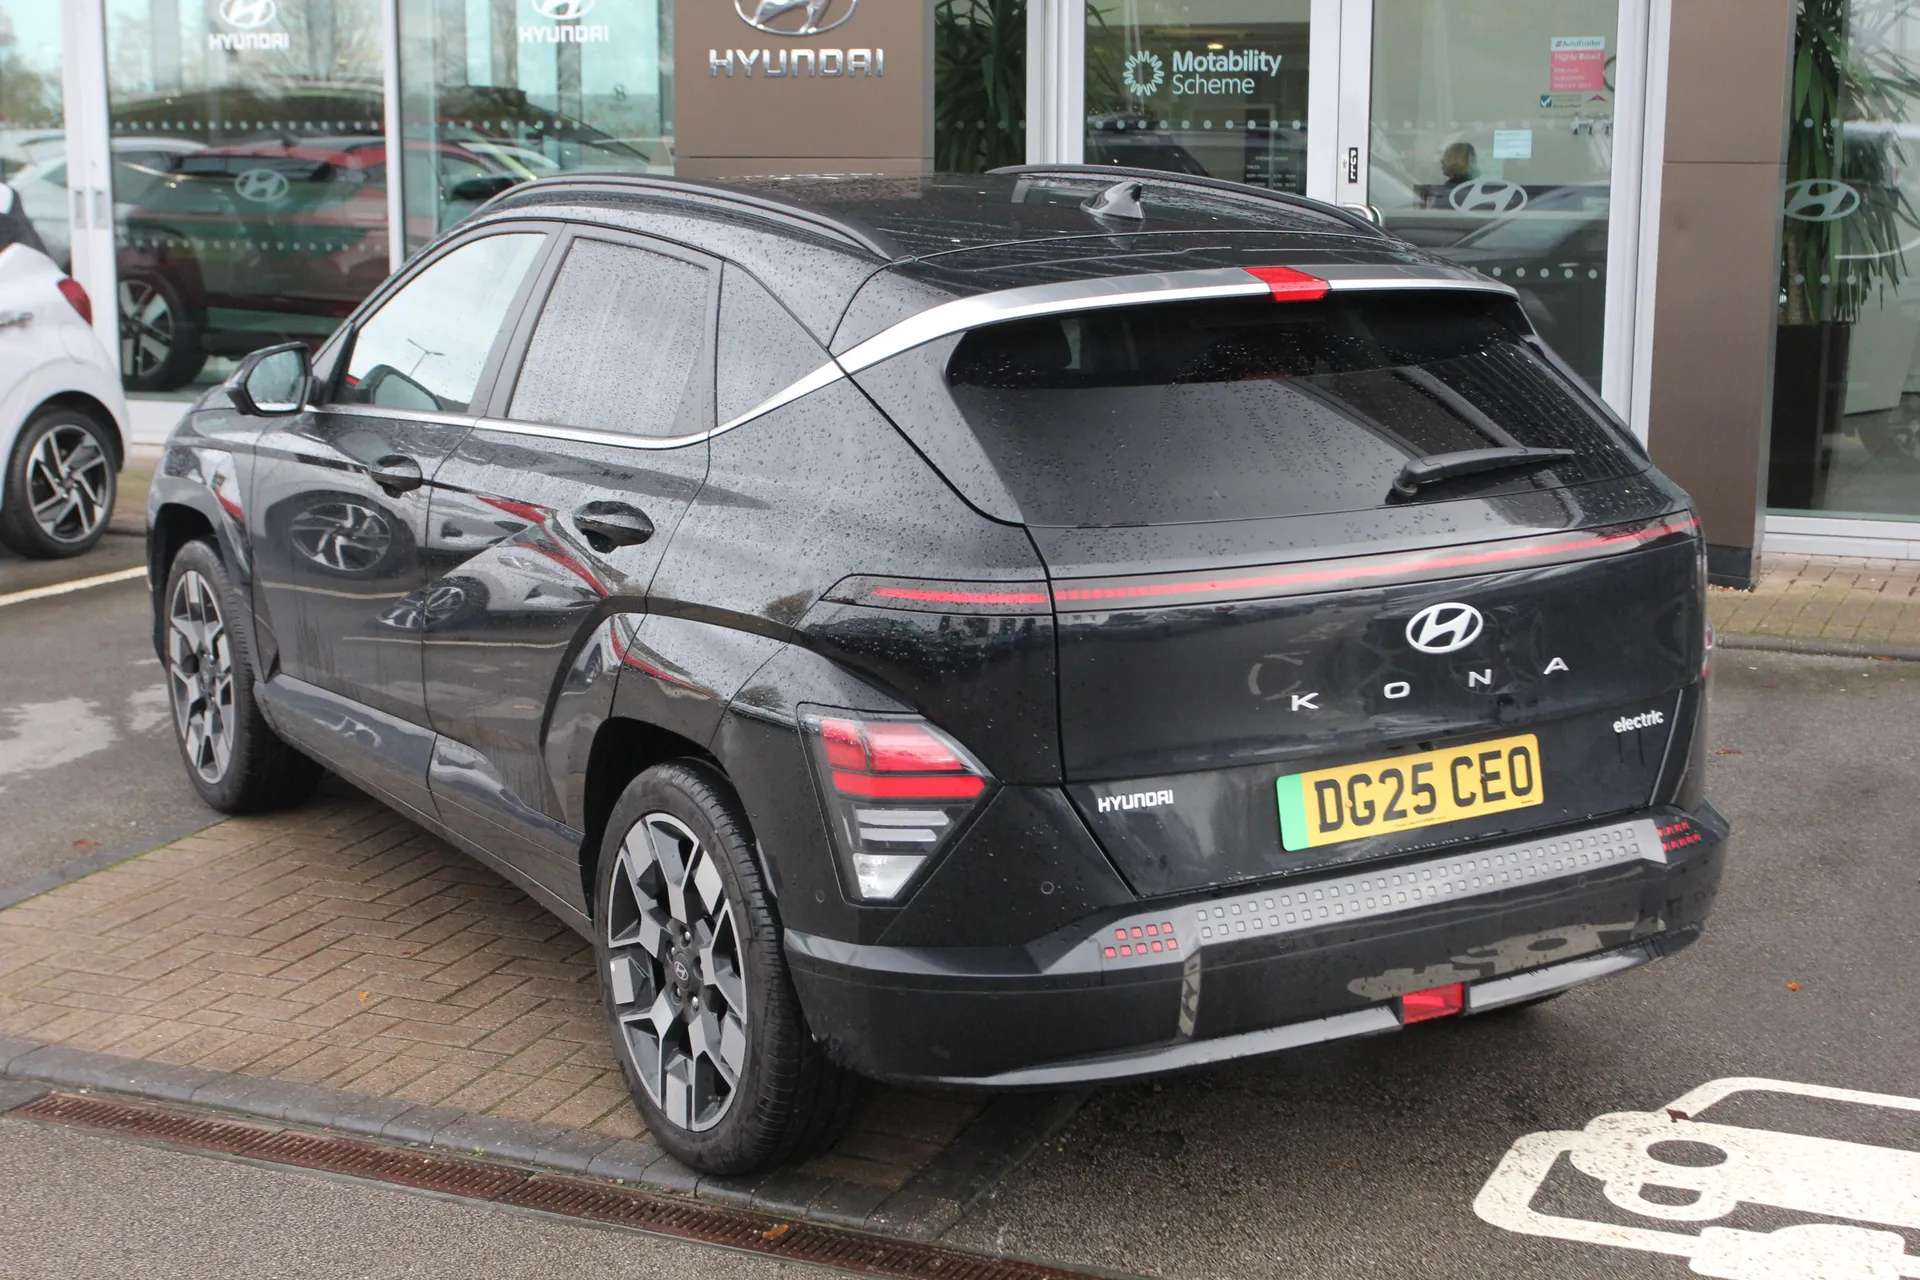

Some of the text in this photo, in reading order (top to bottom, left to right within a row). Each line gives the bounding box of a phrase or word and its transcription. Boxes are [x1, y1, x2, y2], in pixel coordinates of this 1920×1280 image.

[208, 32, 289, 50] HYUNDAI
[519, 25, 609, 43] HYUNDAI
[709, 49, 884, 78] HYUNDAI
[1172, 50, 1282, 77] Motability
[1172, 74, 1255, 95] Scheme
[1290, 656, 1570, 712] KONA
[1613, 710, 1664, 733] electric
[1098, 789, 1174, 813] HYUNDAI
[1314, 746, 1533, 833] DG25 CEO
